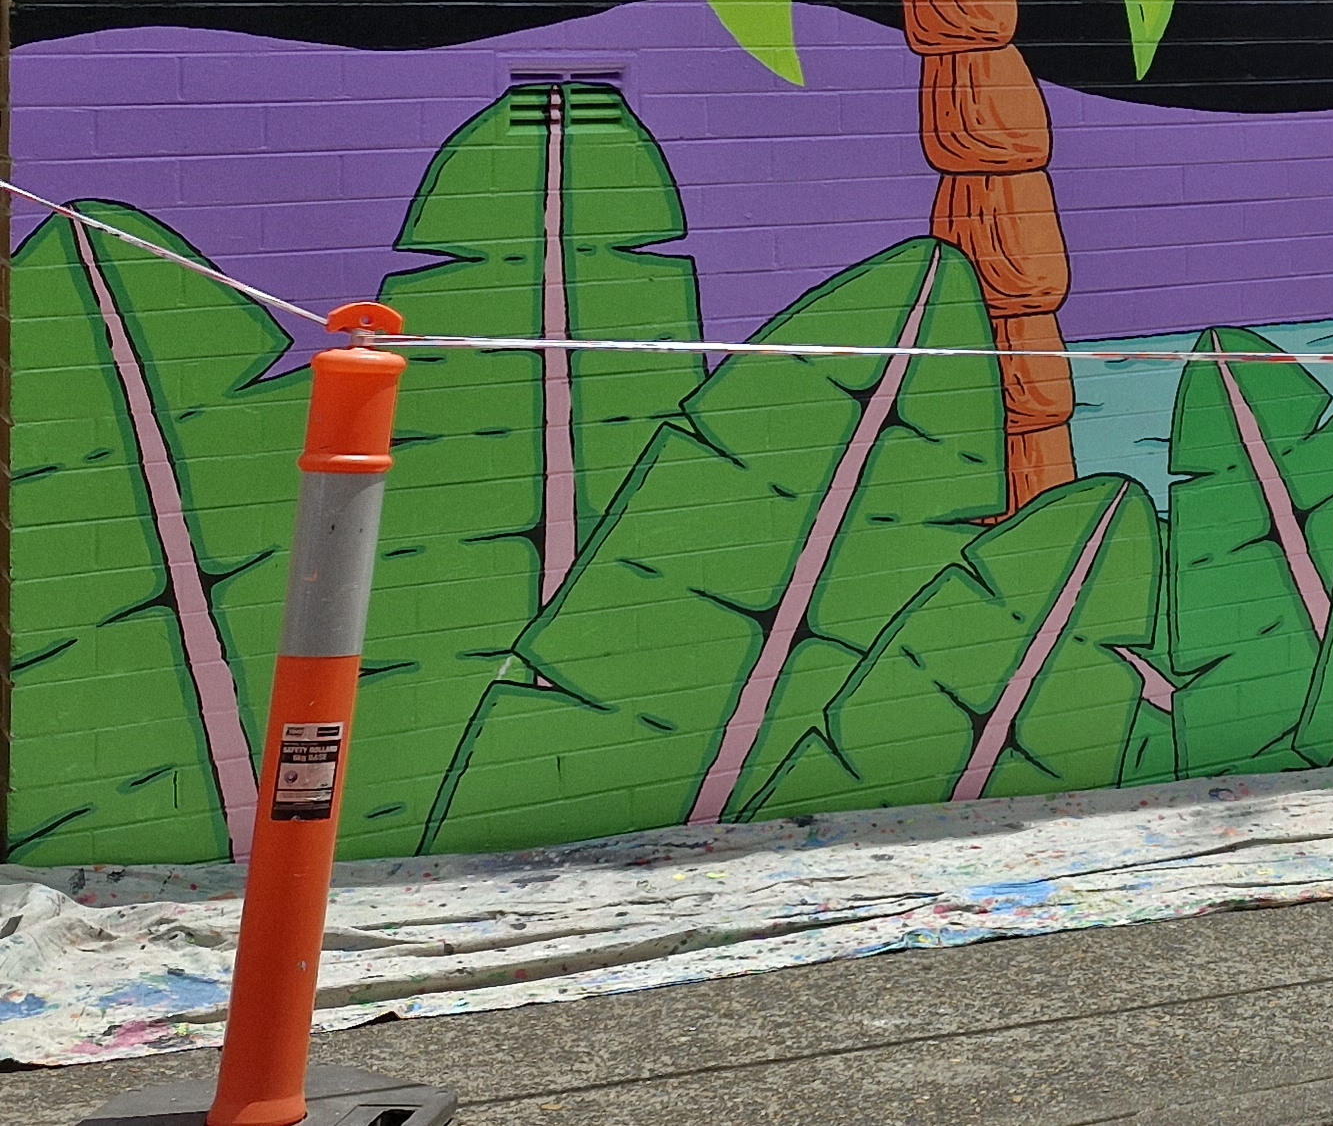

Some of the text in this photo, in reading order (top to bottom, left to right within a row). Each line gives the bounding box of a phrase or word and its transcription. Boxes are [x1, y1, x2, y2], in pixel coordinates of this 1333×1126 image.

[282, 745, 338, 754] SAFETY BOLLARD
[308, 753, 328, 761] BASE
